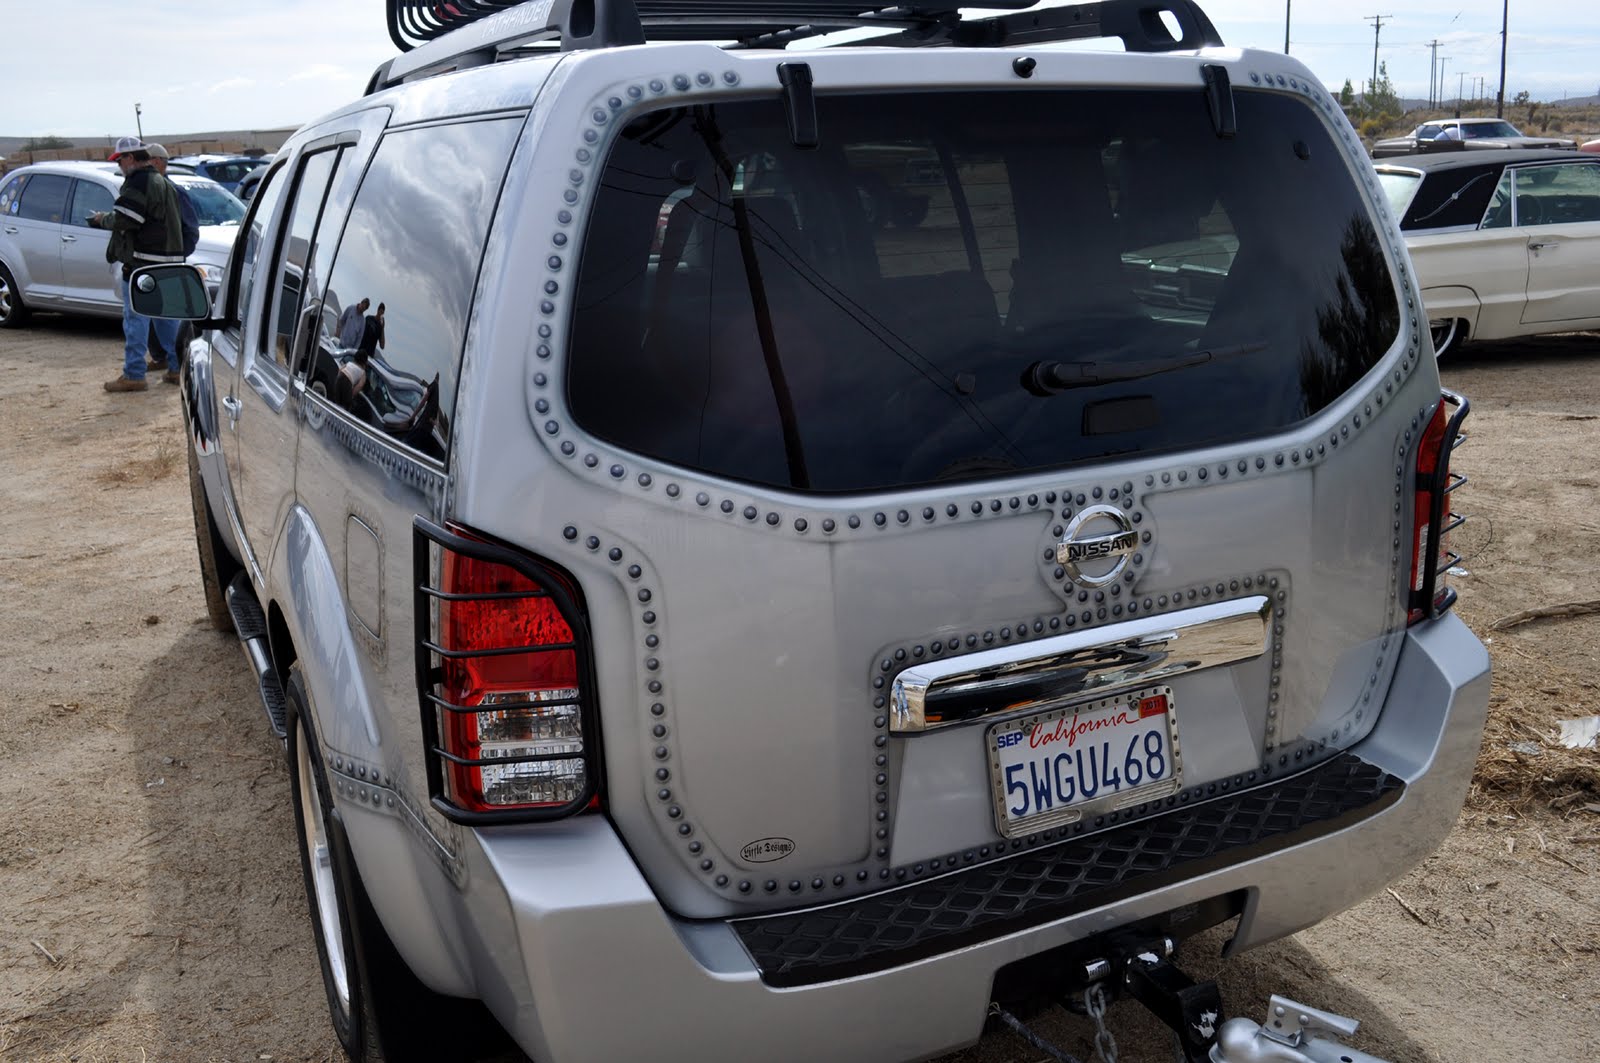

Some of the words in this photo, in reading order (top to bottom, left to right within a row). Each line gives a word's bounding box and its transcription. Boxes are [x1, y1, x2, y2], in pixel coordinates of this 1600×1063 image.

[1069, 538, 1132, 558] NISSAN
[997, 731, 1024, 748] SEP
[1029, 707, 1140, 749] California
[1005, 730, 1165, 816] 5WGU468
